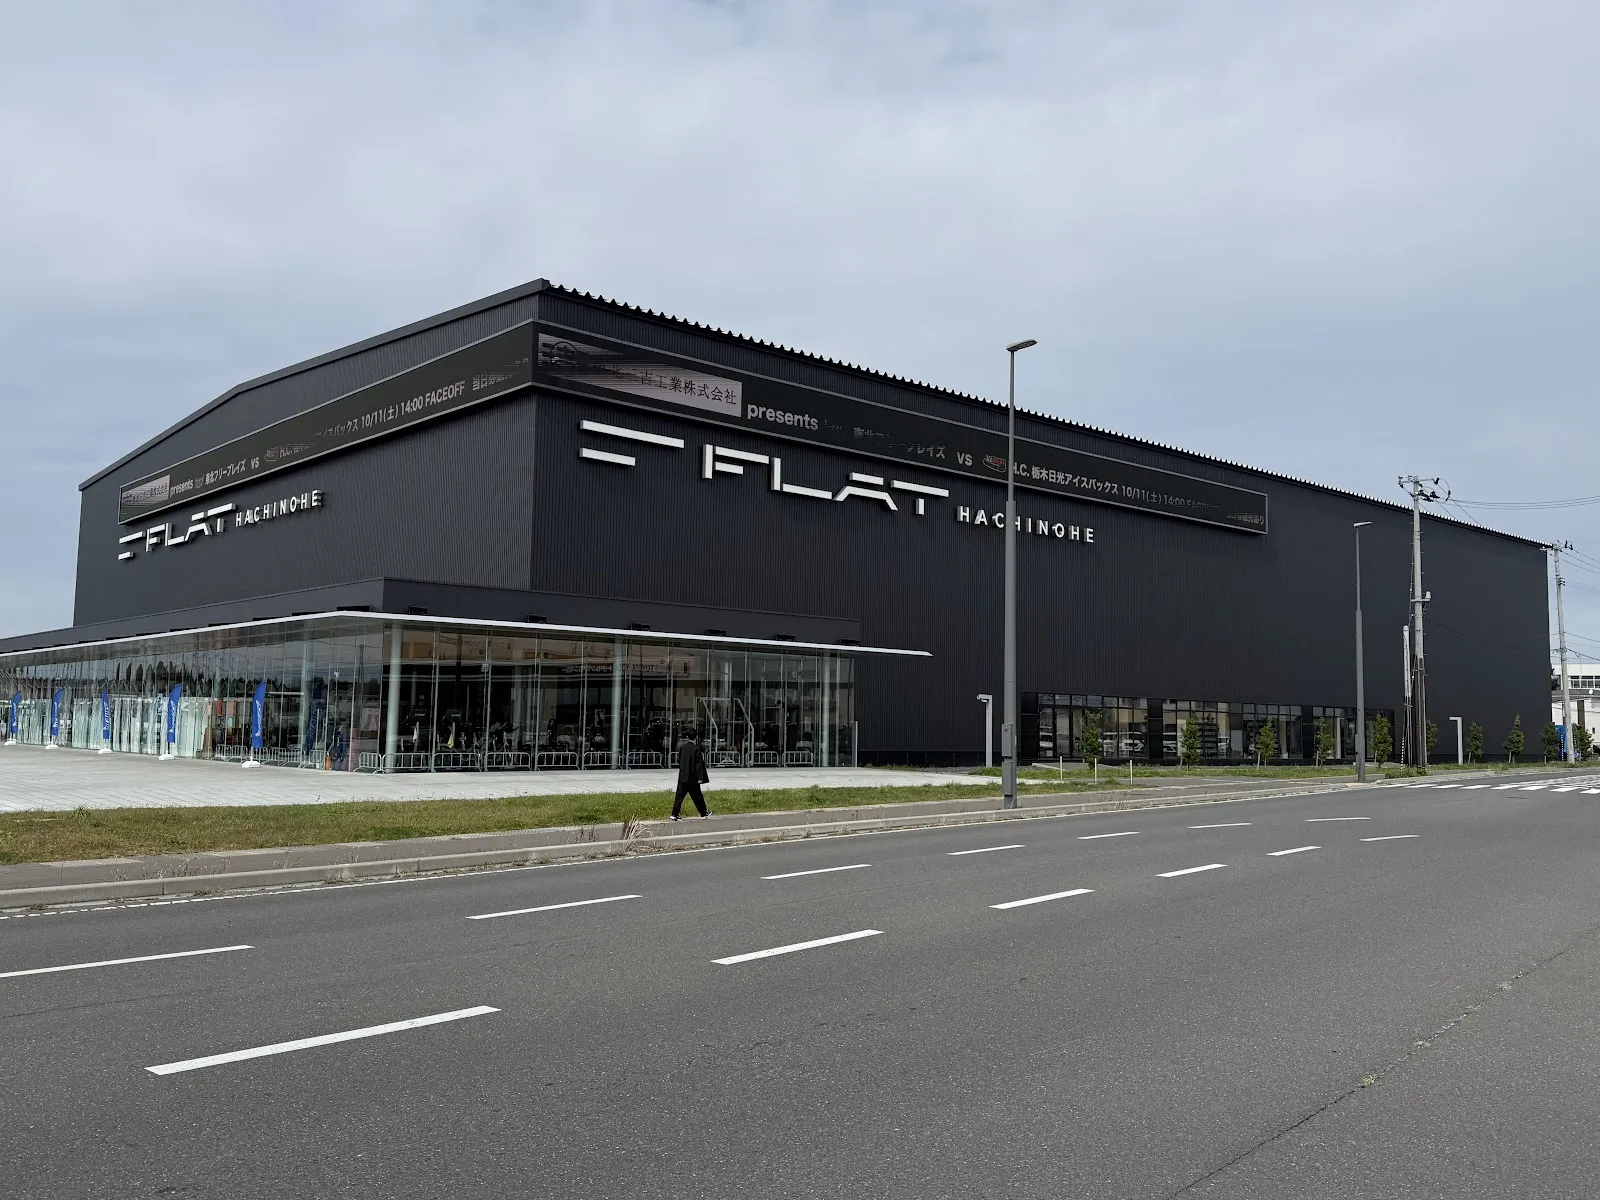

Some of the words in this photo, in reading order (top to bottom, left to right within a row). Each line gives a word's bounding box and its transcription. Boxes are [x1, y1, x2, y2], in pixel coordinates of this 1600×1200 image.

[361, 405, 399, 428] 10/11(土)
[400, 396, 424, 415] 14:00
[425, 380, 465, 407] FACEOFF
[747, 403, 819, 430] presents
[169, 478, 194, 498] presents
[235, 490, 323, 527] HACHINOHE
